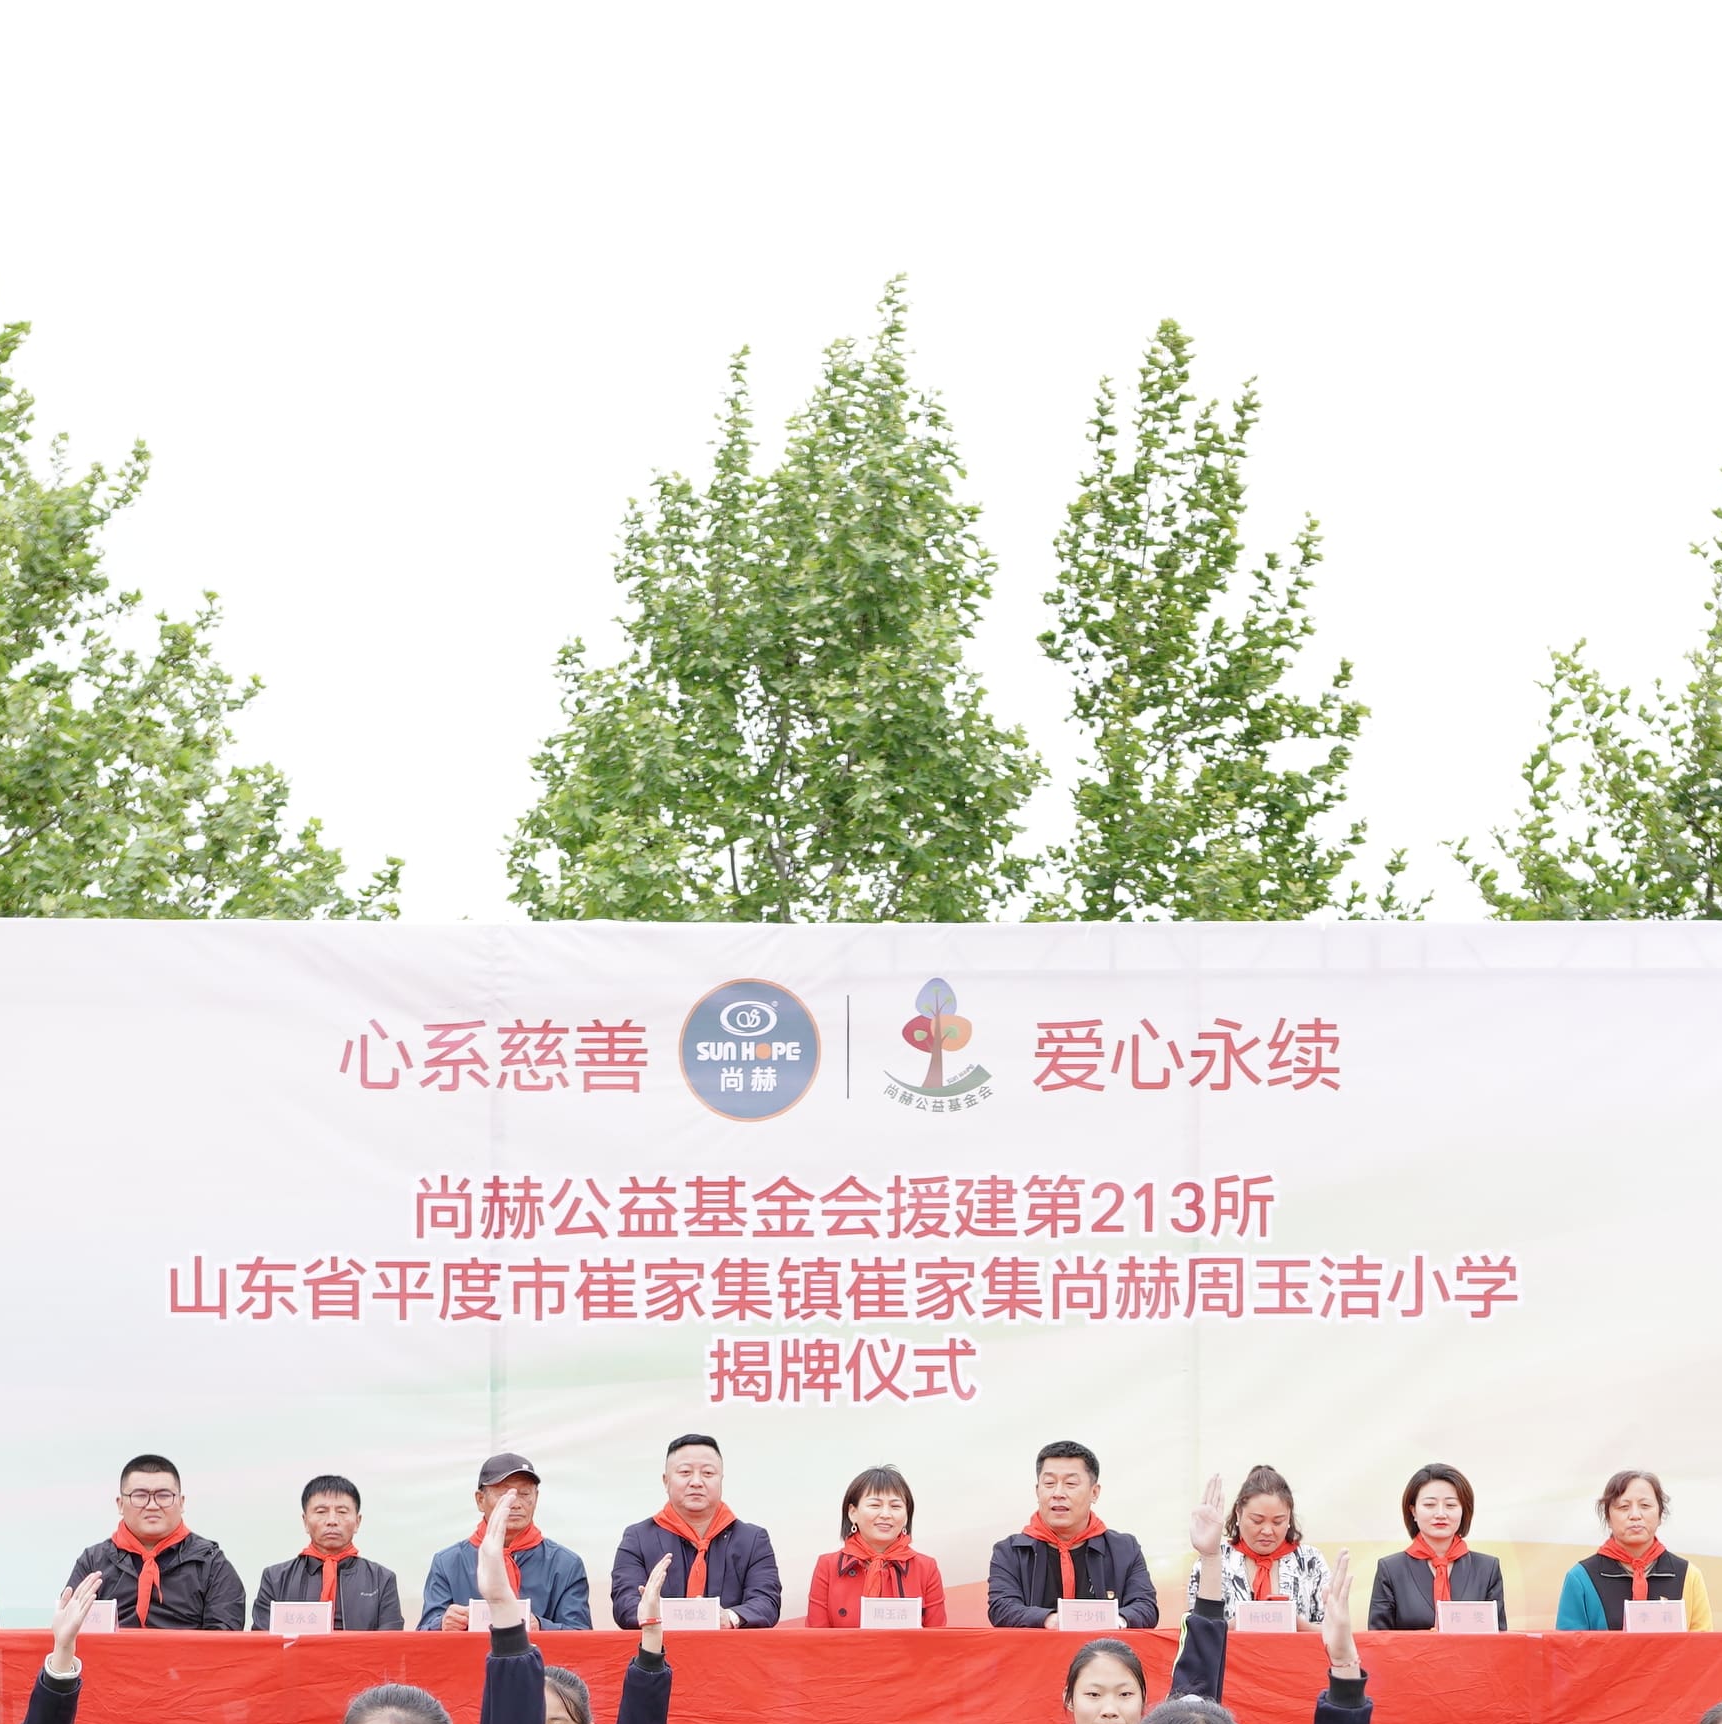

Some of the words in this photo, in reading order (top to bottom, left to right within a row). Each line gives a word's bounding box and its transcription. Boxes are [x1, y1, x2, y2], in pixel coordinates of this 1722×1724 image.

[339, 1018, 649, 1094] 心系慈善
[696, 1041, 737, 1062] SUN
[740, 1041, 802, 1062] HOPE
[720, 1066, 778, 1093] 尚赫
[1032, 1017, 1341, 1093] 爱心永续
[882, 1084, 994, 1114] 尚赫公益基金会
[415, 1173, 1276, 1241] 尚赫公益基金会援建第213所
[168, 1254, 1519, 1323] 山东省平度市崔家集镇崔家集尚赫周玉洁小学
[708, 1337, 978, 1404] 揭牌仪式
